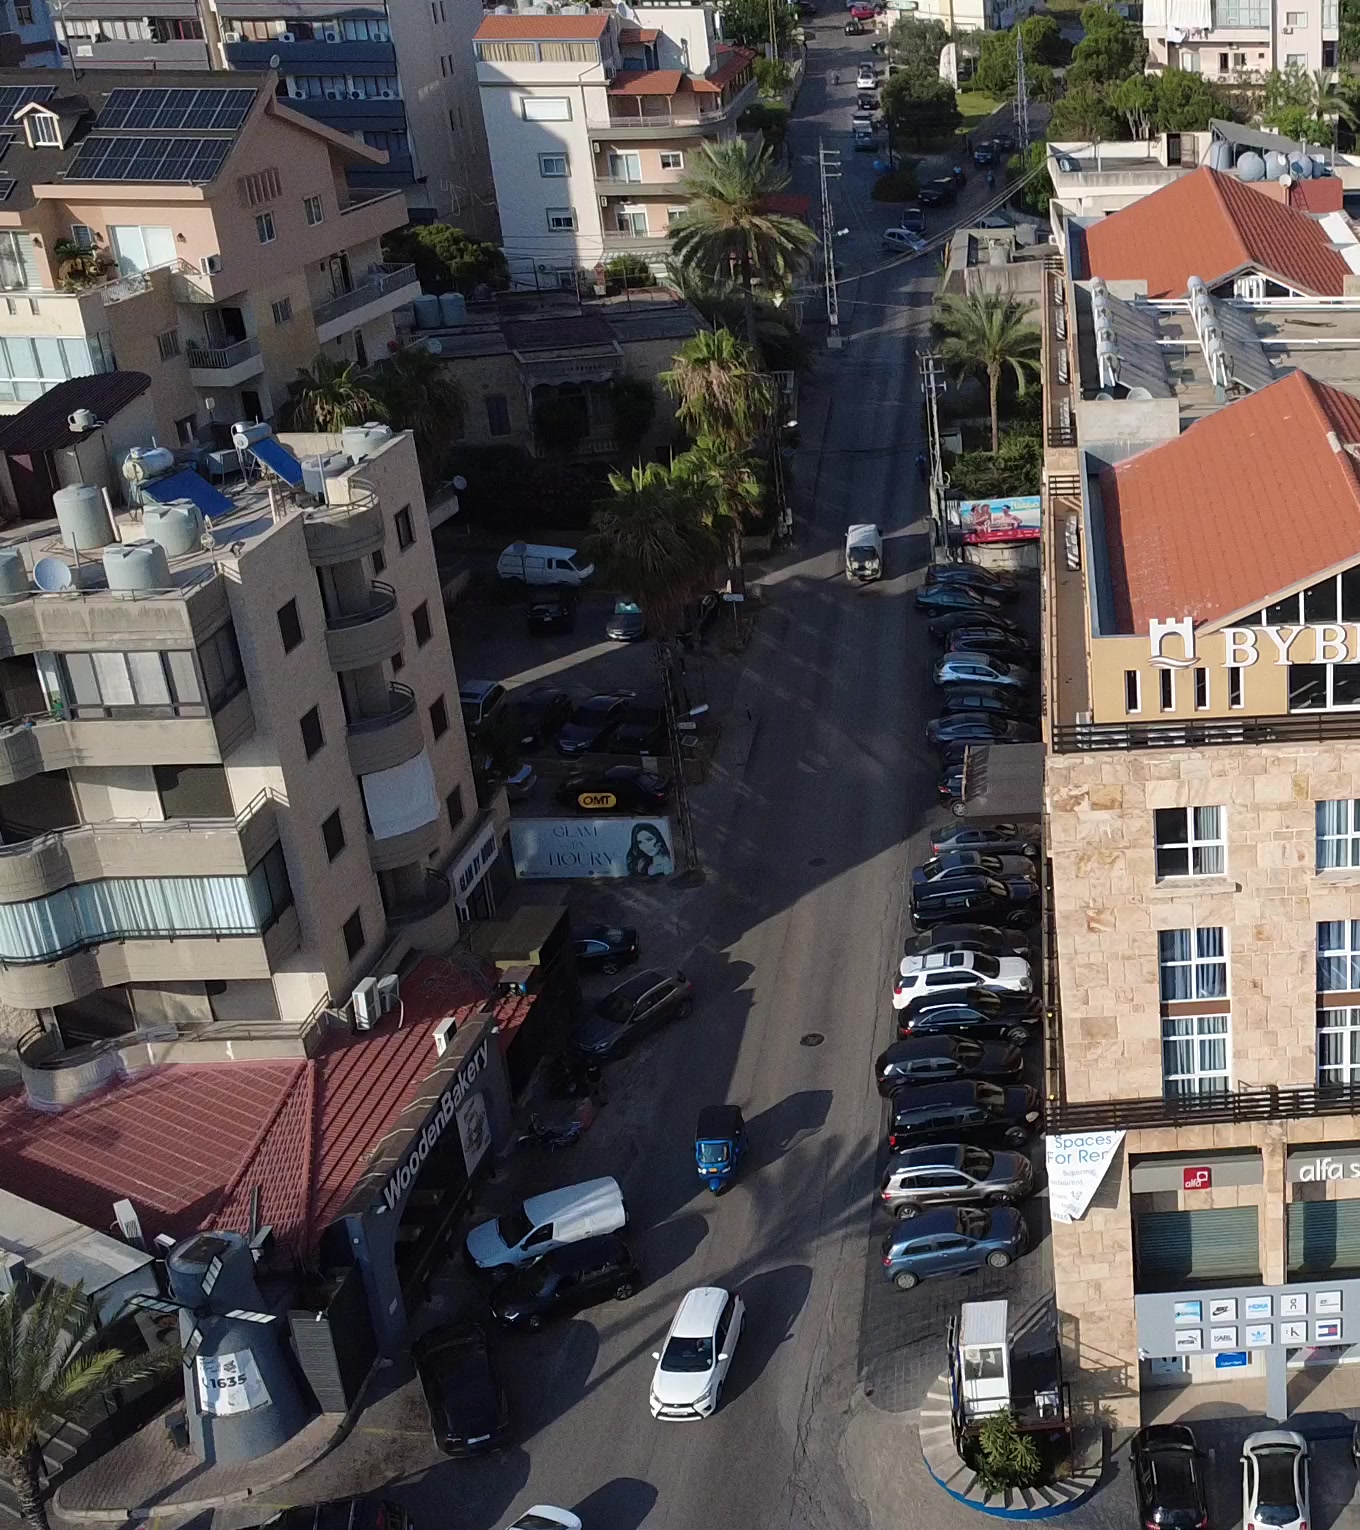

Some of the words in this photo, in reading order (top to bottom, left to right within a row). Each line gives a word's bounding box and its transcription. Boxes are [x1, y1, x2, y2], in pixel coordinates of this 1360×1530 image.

[582, 795, 612, 806] OMT
[553, 825, 597, 838] GLAM
[549, 852, 614, 866] HOURY
[1055, 1134, 1112, 1150] Spaces
[1047, 1151, 1072, 1165] For
[1079, 1149, 1109, 1163] Re
[1300, 1157, 1343, 1181] alfa
[210, 1373, 247, 1389] 1635
